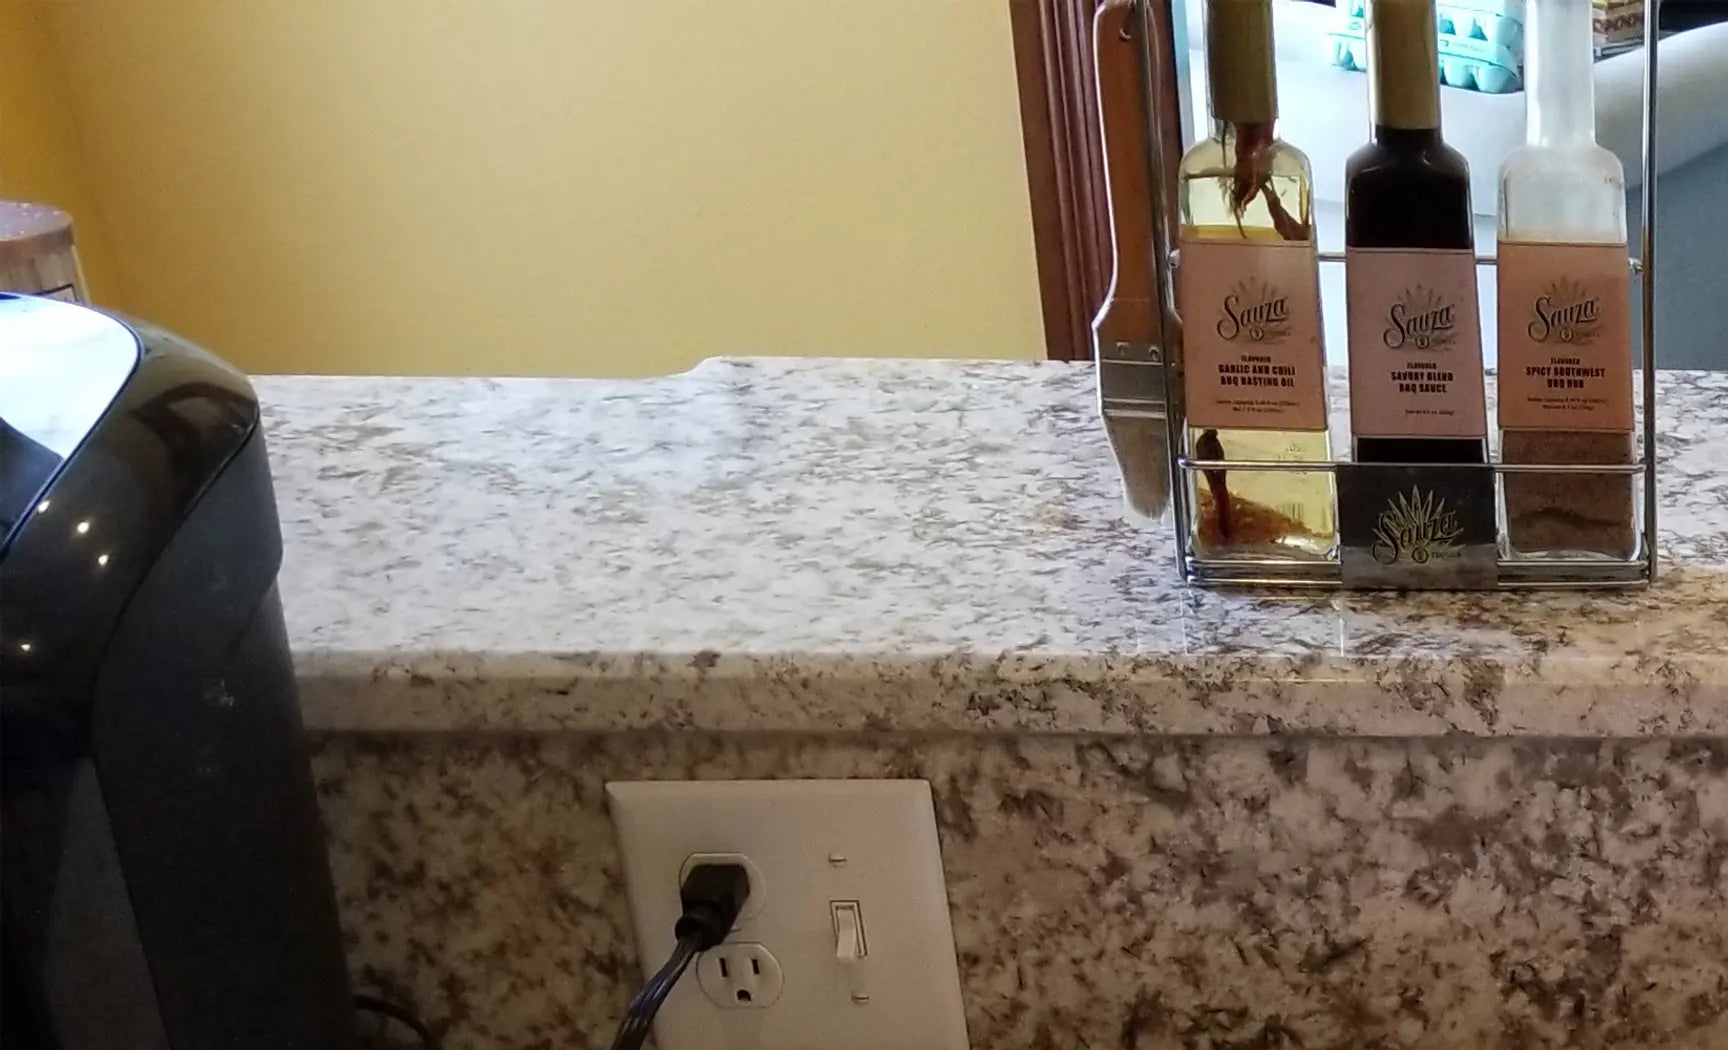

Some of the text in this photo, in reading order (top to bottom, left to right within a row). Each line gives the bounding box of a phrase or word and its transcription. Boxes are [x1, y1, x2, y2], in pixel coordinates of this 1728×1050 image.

[1217, 295, 1289, 341] Sauza
[1528, 296, 1599, 341] Sauza
[1383, 303, 1456, 349] Sauza
[1218, 364, 1250, 374] GARLIC
[1272, 366, 1295, 376] CHILI
[1391, 371, 1454, 381] SAVORY BLEND
[1526, 366, 1606, 378] SPICY SOUTHWEST
[1240, 376, 1279, 387] BASTING
[1280, 377, 1295, 388] OIL
[1399, 383, 1447, 393] BBQ SAUCE
[1371, 510, 1461, 564] Sauza
